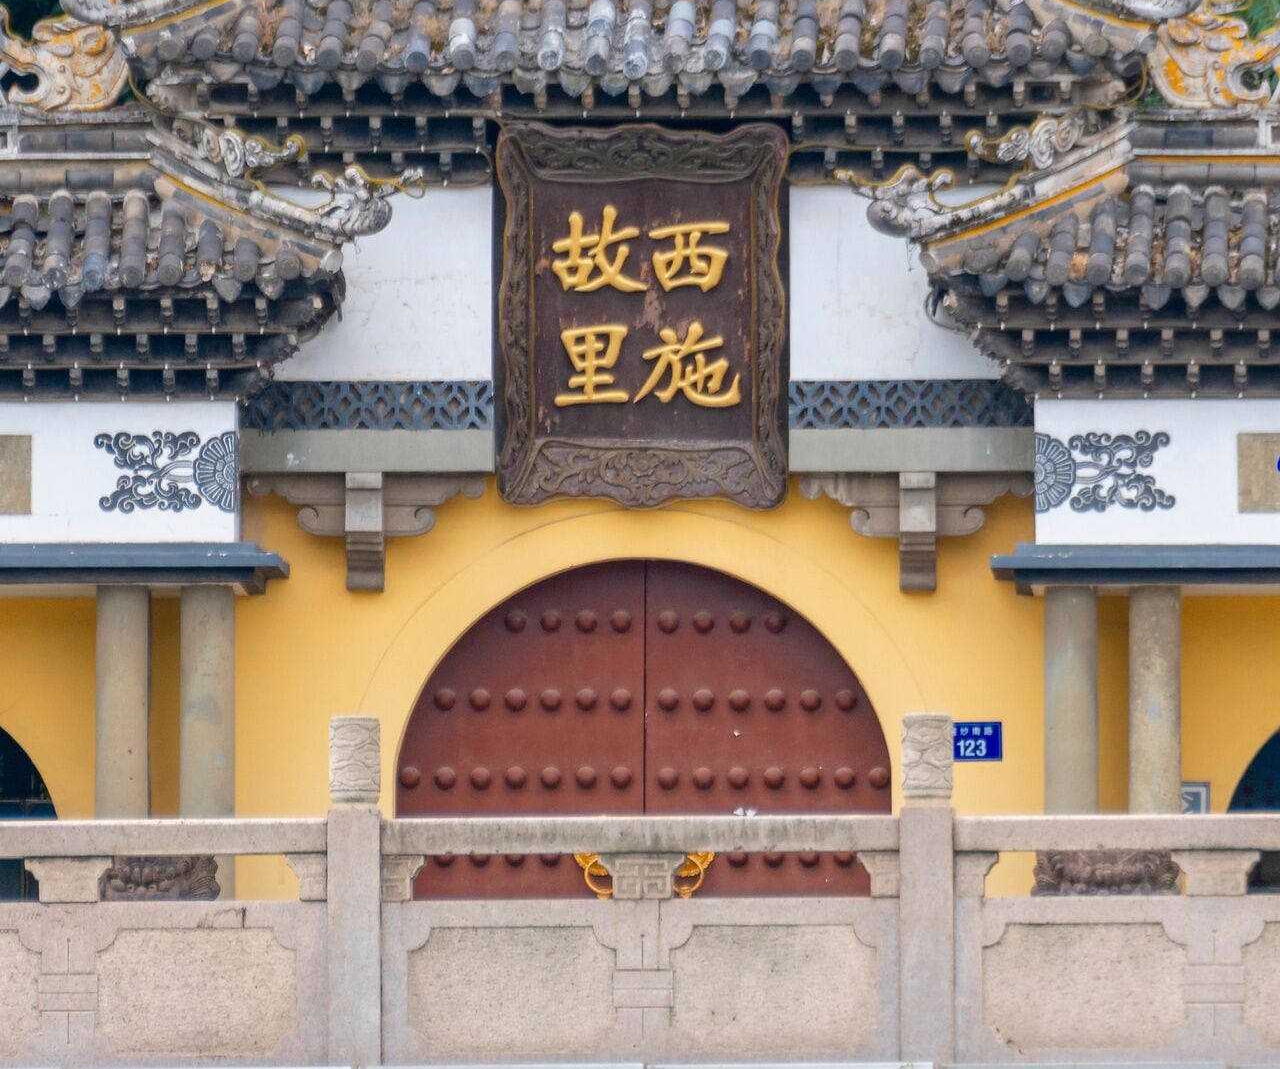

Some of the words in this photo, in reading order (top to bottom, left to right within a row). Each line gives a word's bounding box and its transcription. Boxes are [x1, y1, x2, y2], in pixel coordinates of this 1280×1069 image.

[551, 204, 648, 407] 故里
[633, 221, 742, 408] 西施
[956, 739, 987, 758] 123
